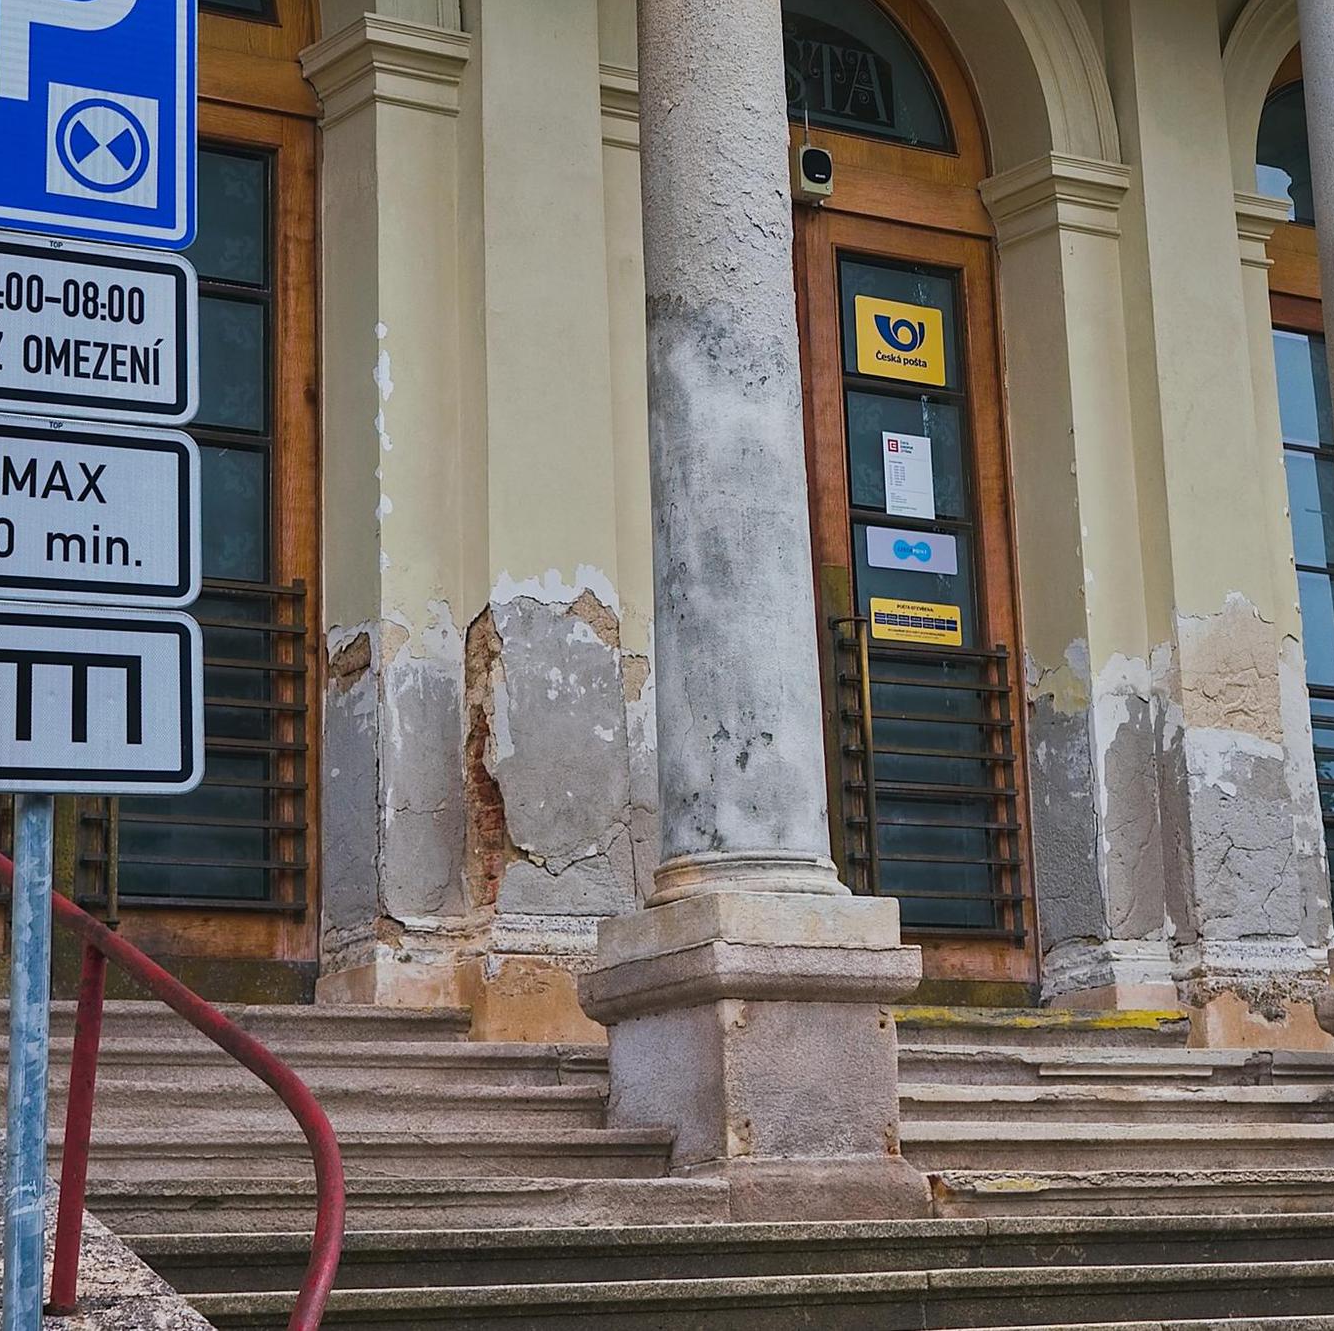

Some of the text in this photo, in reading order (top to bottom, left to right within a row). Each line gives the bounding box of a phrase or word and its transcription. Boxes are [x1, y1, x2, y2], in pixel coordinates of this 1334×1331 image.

[49, 240, 64, 248] TOP
[22, 335, 164, 386] OMEZENÍ
[875, 350, 928, 368] Česká pošta
[49, 421, 64, 429] TOP
[1, 455, 108, 504] MAX
[46, 525, 143, 568] min.
